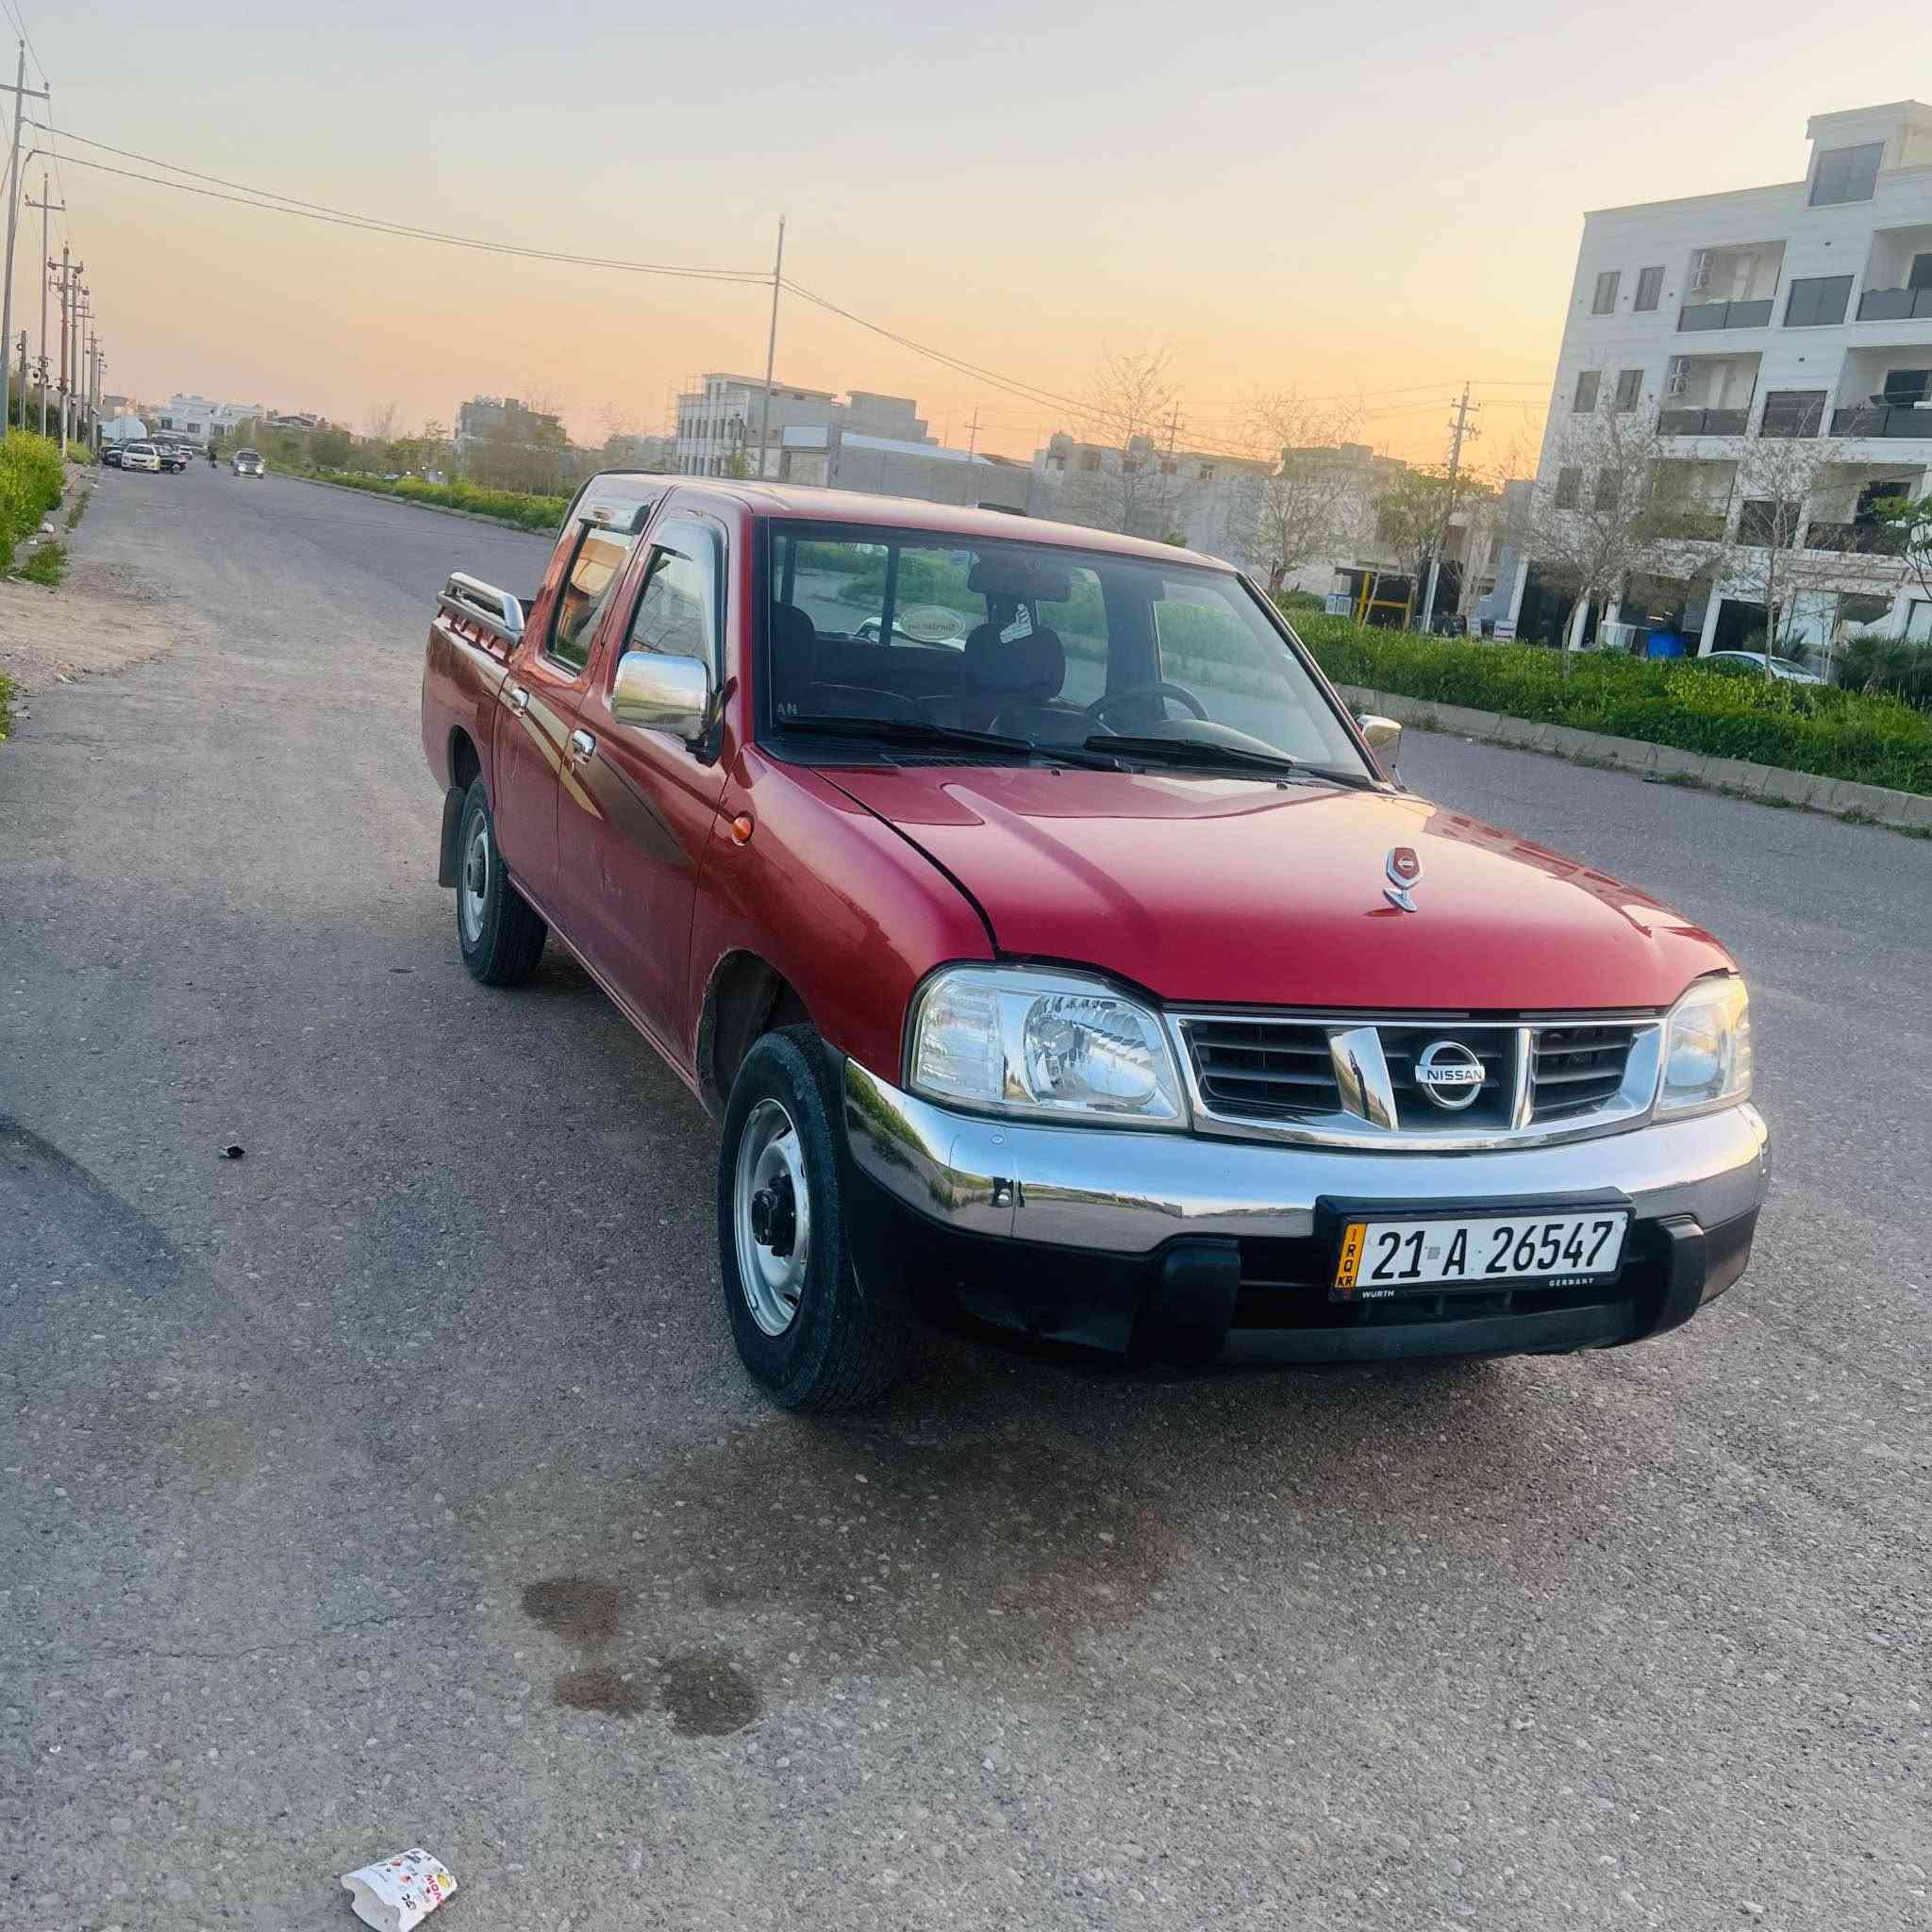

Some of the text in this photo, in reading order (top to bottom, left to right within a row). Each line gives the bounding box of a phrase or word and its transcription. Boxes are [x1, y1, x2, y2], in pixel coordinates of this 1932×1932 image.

[1427, 1070, 1482, 1081] NISSAN
[1371, 1221, 1614, 1280] 21 A 26547
[1338, 1275, 1353, 1287] KR
